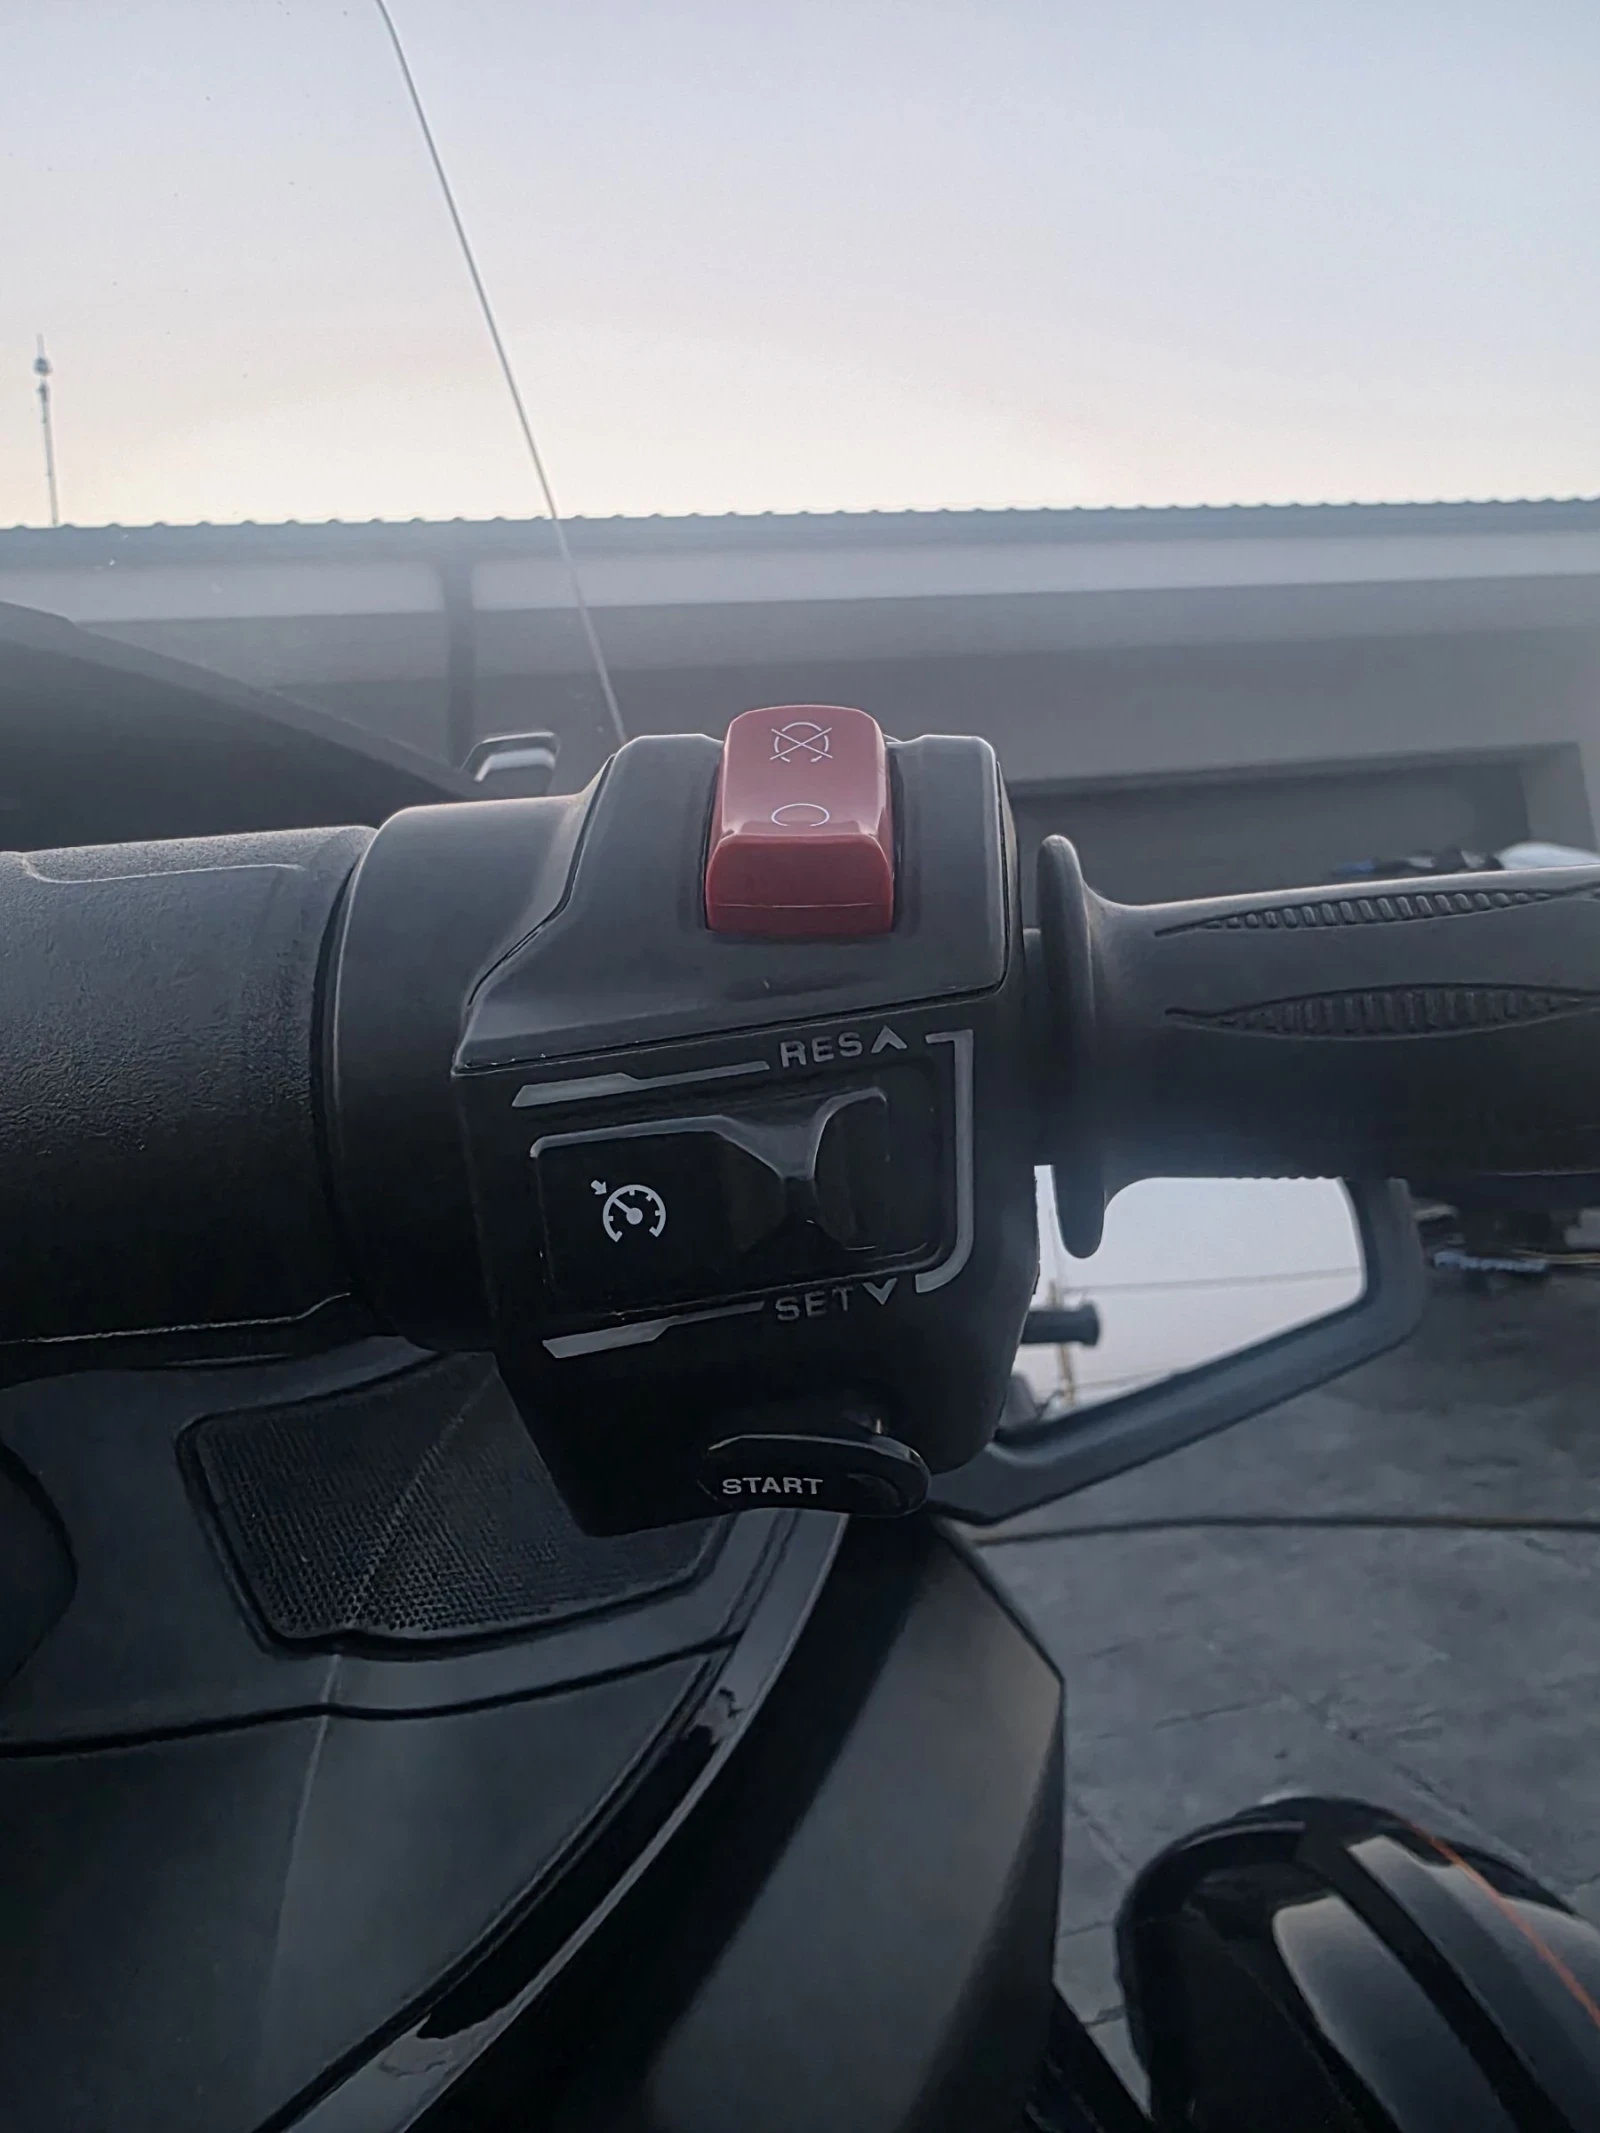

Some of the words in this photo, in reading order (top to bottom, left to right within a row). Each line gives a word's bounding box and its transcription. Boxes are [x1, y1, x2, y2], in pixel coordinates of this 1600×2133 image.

[780, 1032, 863, 1068] RES
[775, 1286, 854, 1321] SET
[722, 1477, 824, 1495] START
